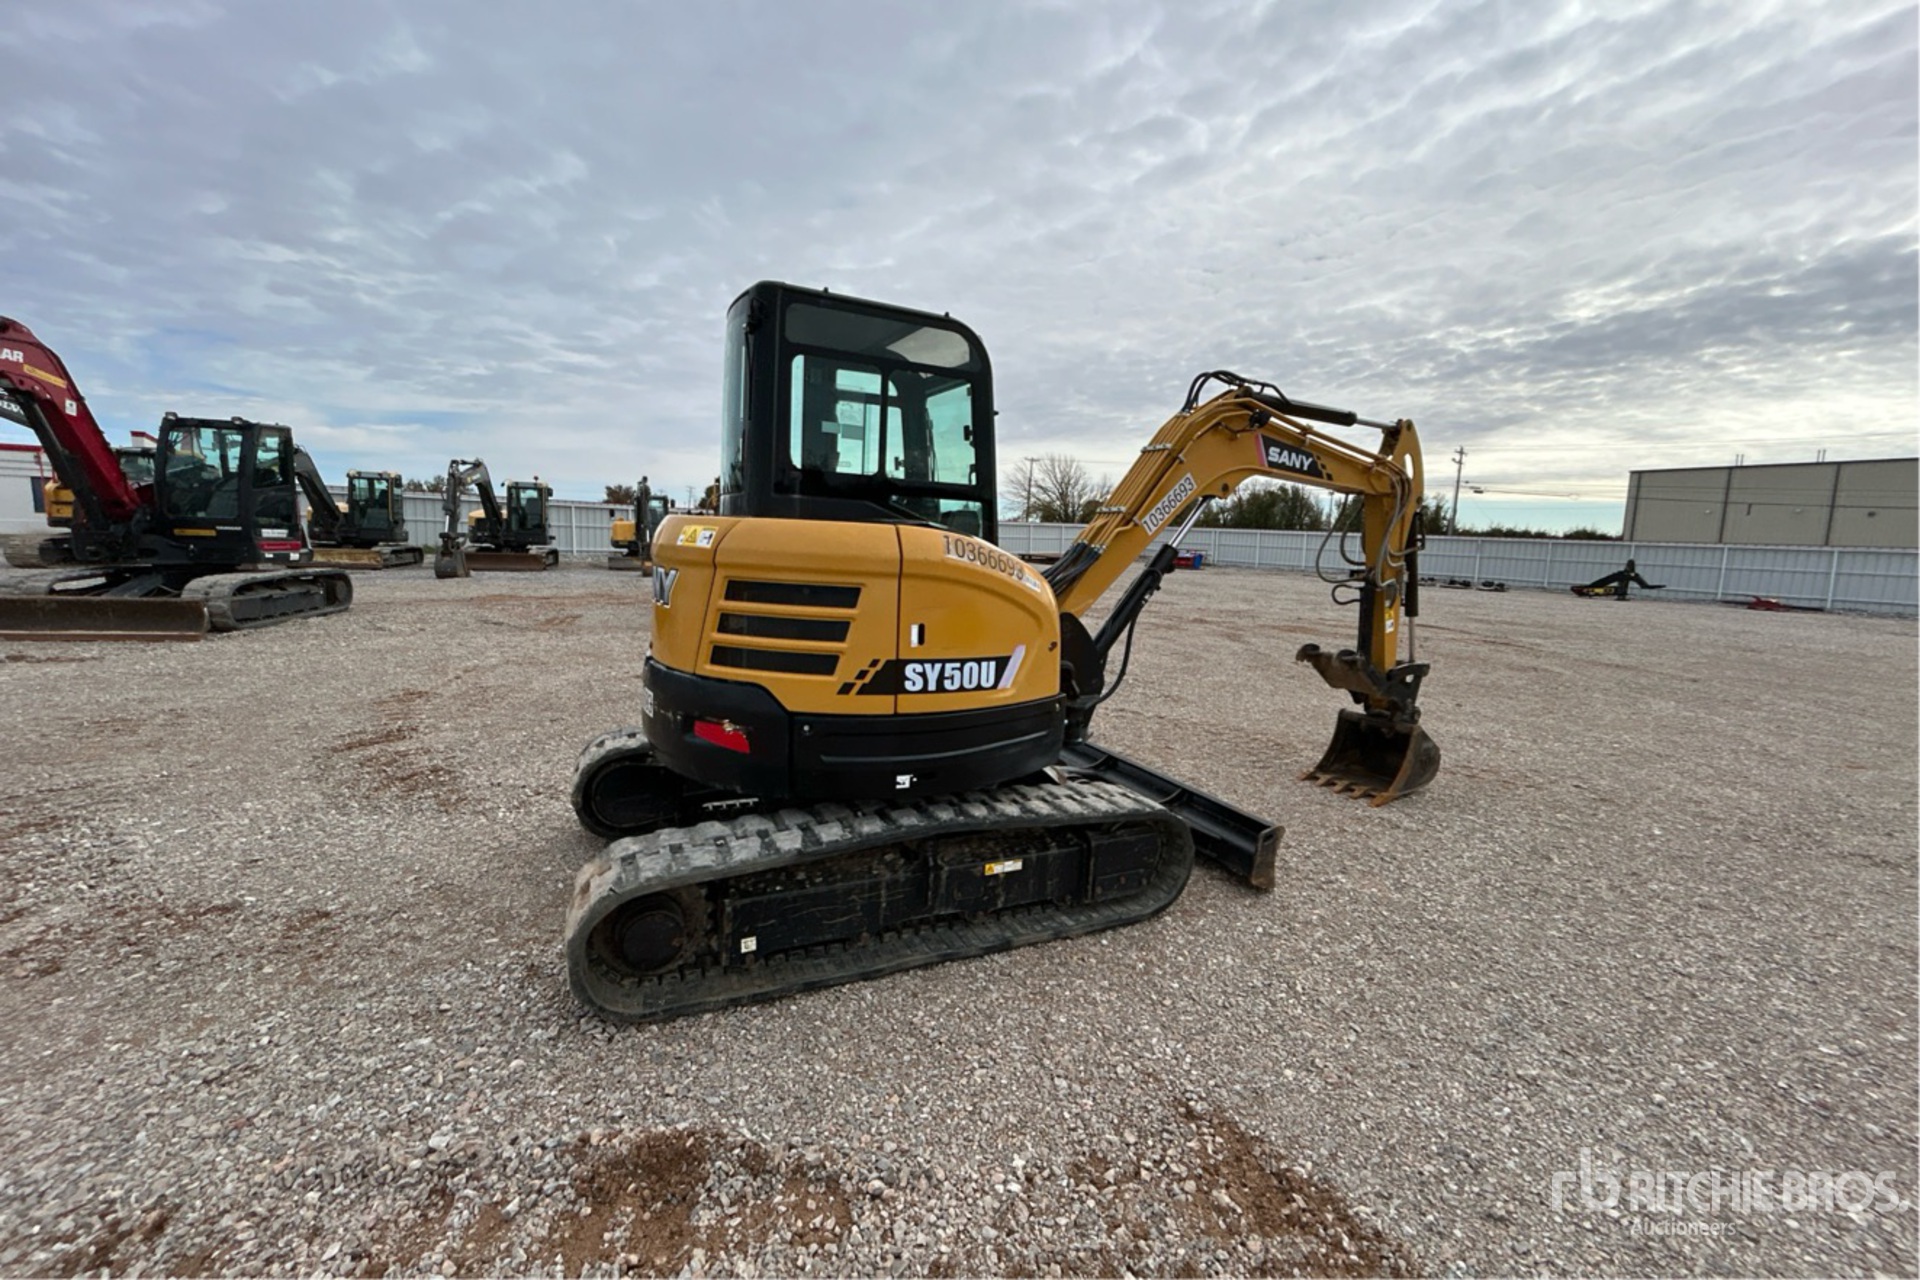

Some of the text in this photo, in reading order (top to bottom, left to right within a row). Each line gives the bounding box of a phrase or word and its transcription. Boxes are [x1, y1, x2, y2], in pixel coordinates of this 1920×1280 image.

[1268, 446, 1313, 471] SANY
[1143, 476, 1195, 533] 10366693
[943, 535, 1024, 581] 10366693
[904, 661, 997, 692] SY50U
